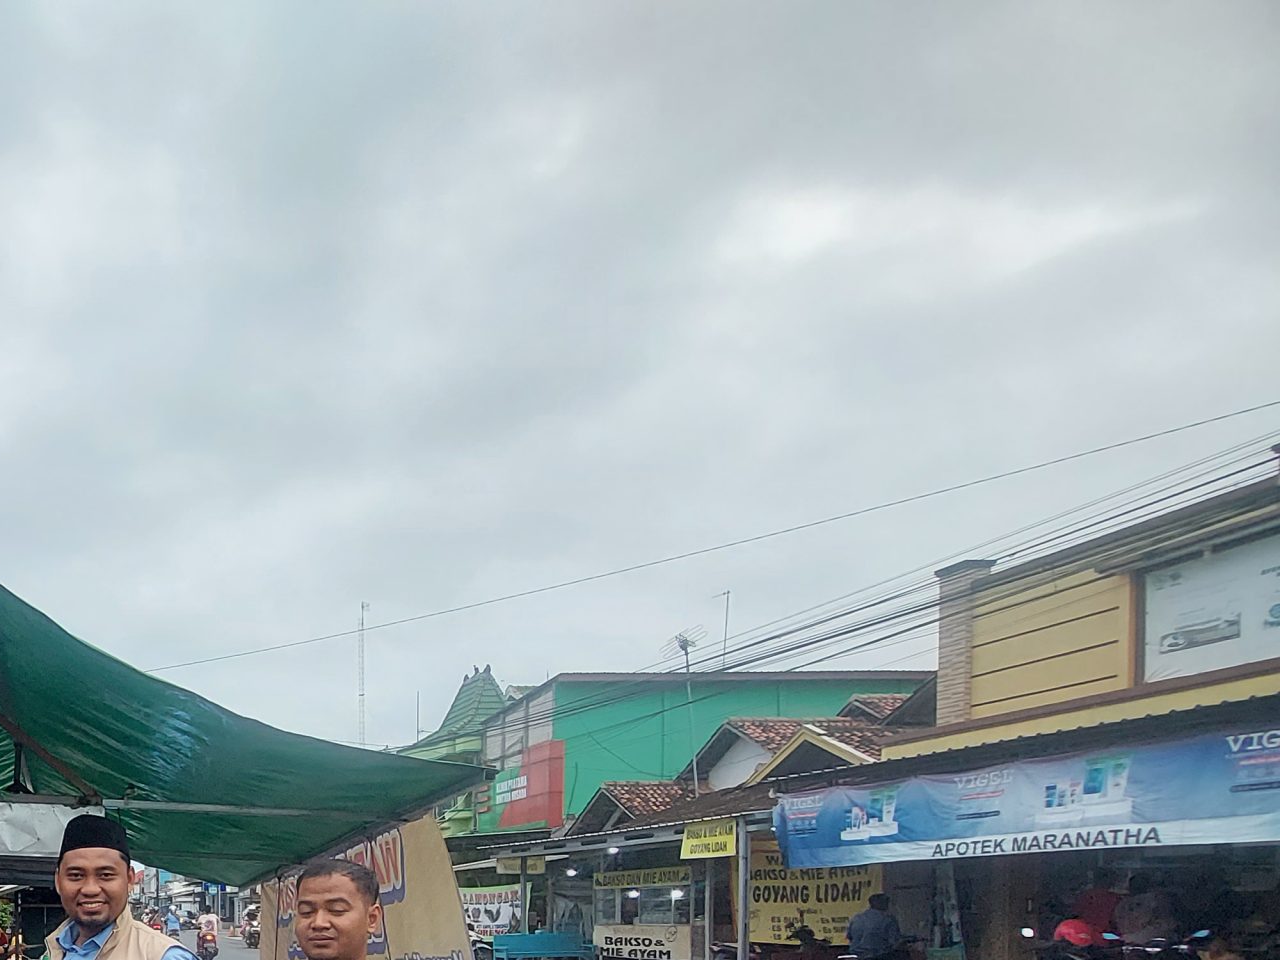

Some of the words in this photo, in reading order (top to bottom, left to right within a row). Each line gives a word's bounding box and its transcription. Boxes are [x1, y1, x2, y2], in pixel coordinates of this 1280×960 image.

[954, 769, 1014, 789] VIGEL
[689, 843, 711, 854] GOYANG
[711, 841, 728, 852] LIDAH
[931, 838, 1006, 858] APOTEK
[1011, 826, 1161, 852] MARANATHA
[603, 874, 625, 887] BAKSO
[642, 871, 657, 885] MIE
[659, 869, 681, 883] AYAM
[750, 868, 788, 881] AKSO
[800, 868, 825, 881] MIE
[604, 936, 653, 948] BAKSO
[654, 939, 666, 947] &
[600, 946, 624, 957] MIE
[627, 948, 671, 960] AYAM
